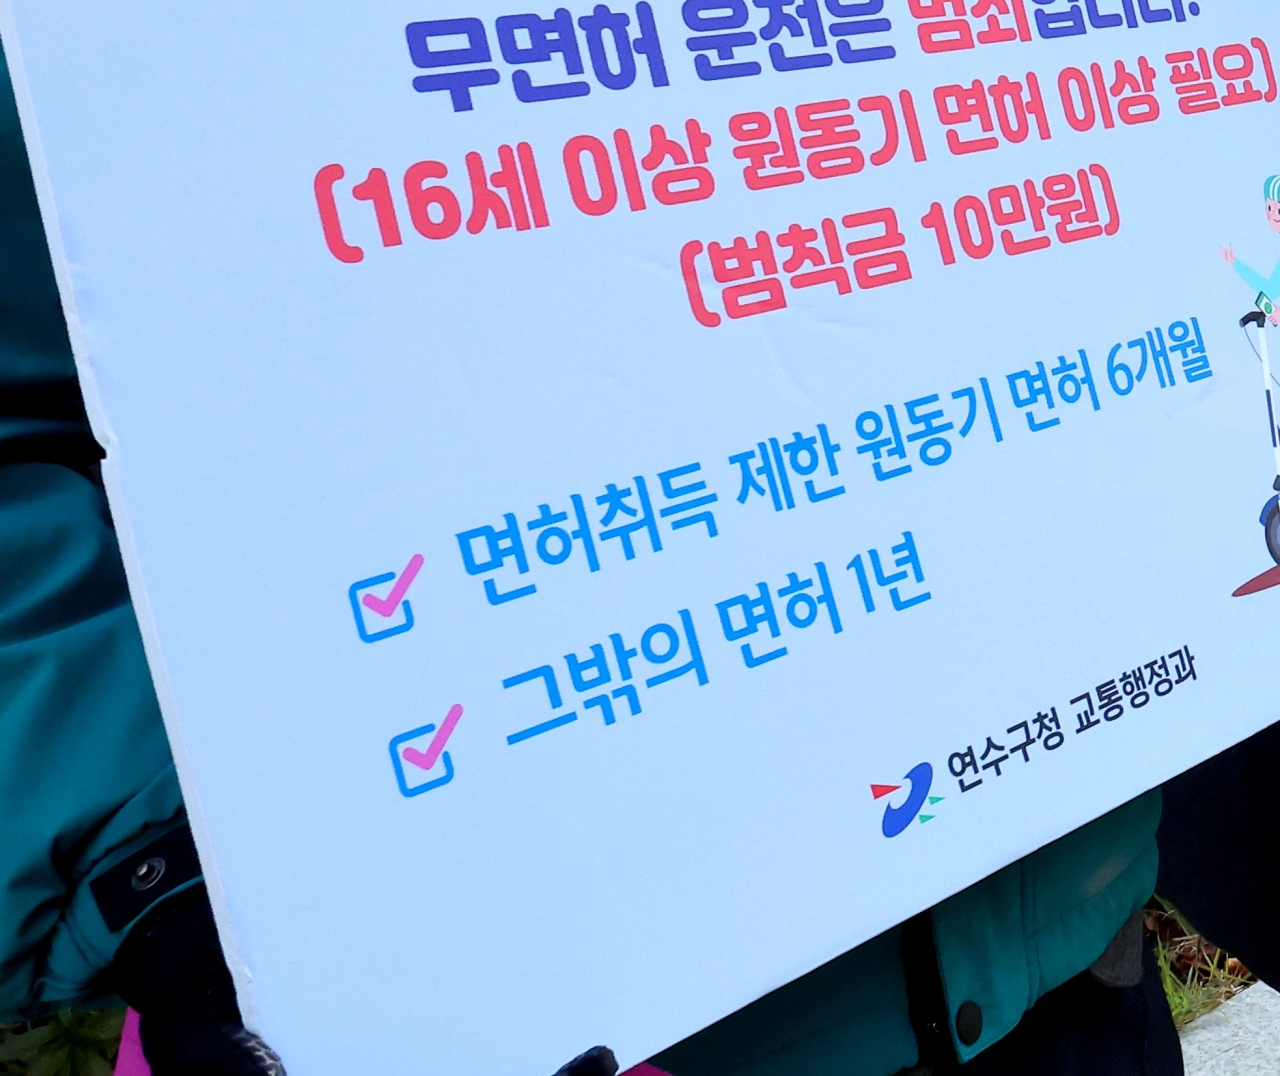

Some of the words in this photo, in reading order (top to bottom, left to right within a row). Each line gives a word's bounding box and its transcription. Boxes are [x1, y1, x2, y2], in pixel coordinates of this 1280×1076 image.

[312, 141, 551, 264] (16세
[562, 117, 719, 217] 이상
[729, 88, 929, 193] 원동기
[932, 66, 1052, 155] 면허
[1058, 53, 1162, 134] 이상
[1165, 36, 1280, 113] 필요)
[403, 0, 670, 113] 무면허
[678, 204, 914, 328] (범칙금
[920, 161, 1122, 268] 10만원)
[454, 460, 720, 607] 면허취득
[727, 422, 844, 511] 제한
[853, 375, 1005, 481] 원동기
[1006, 346, 1102, 433] 면허
[1103, 317, 1215, 409] 6개월
[499, 608, 711, 747] 그밖의
[714, 559, 845, 670] 면허
[845, 531, 934, 615] 1년
[947, 706, 1062, 794] 연수구청
[1068, 645, 1198, 738] 교통행정과
